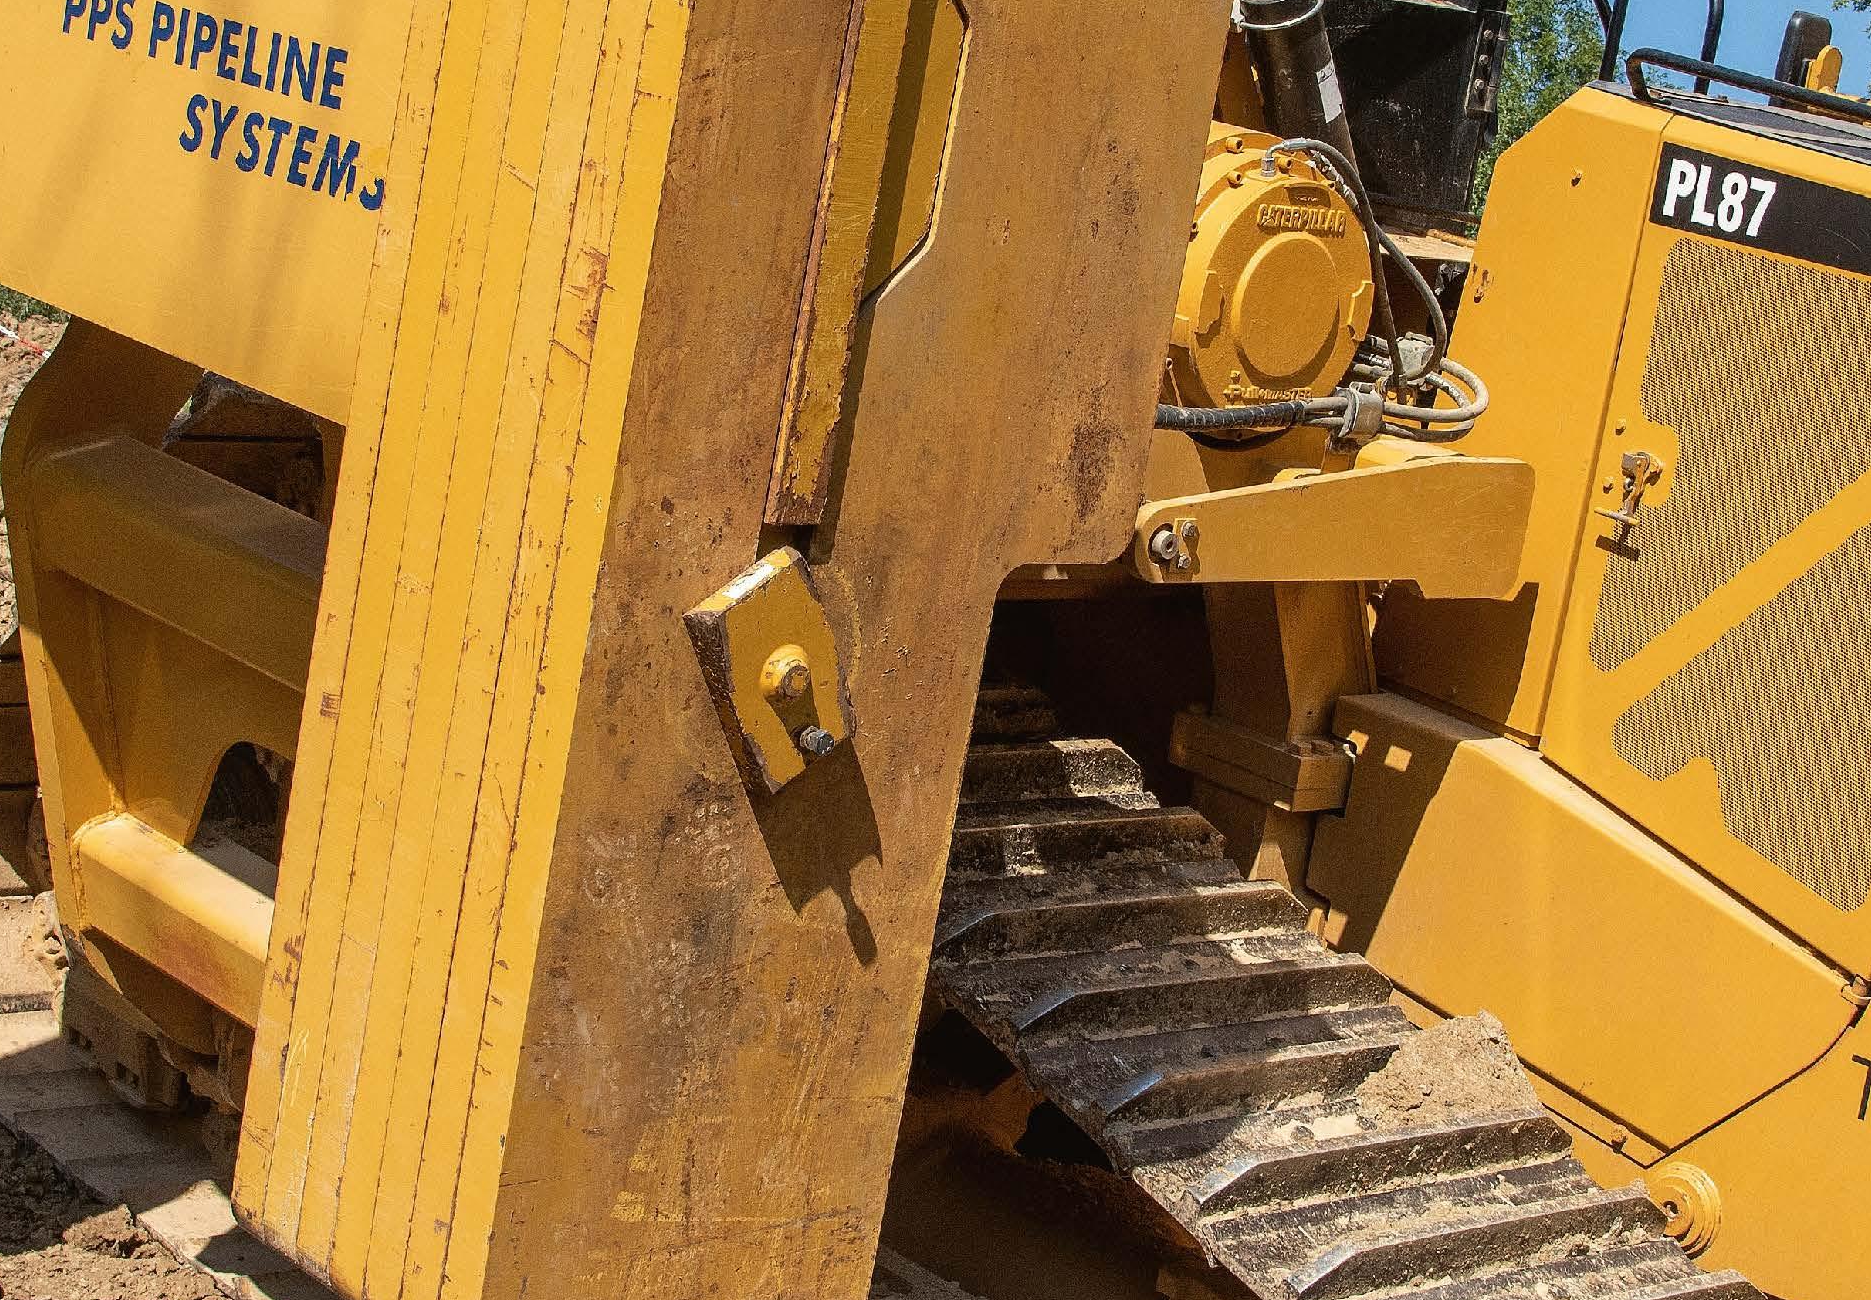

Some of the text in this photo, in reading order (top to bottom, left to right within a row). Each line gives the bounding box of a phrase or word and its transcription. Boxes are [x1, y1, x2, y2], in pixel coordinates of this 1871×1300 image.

[148, 0, 349, 111] PIPELINE
[1257, 203, 1347, 236] CATERPILLAR
[1662, 158, 1777, 238] PL87
